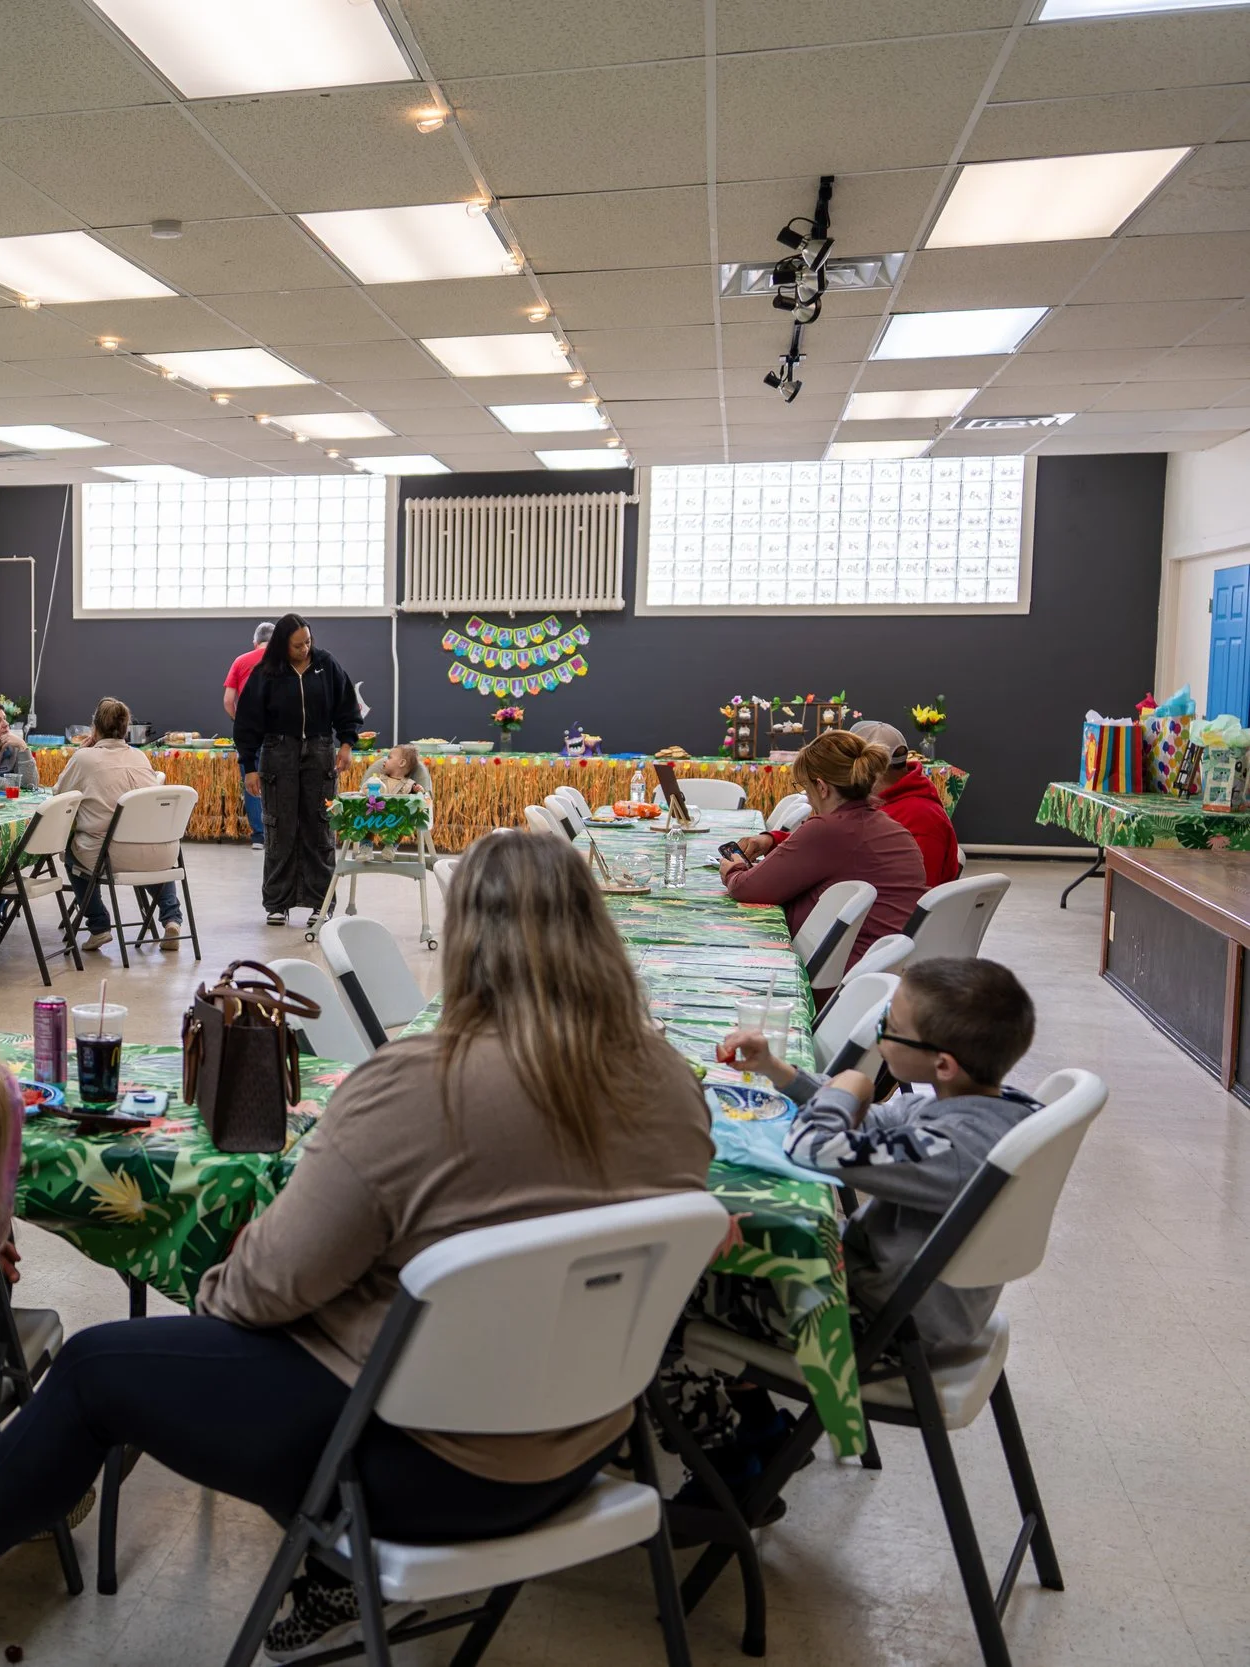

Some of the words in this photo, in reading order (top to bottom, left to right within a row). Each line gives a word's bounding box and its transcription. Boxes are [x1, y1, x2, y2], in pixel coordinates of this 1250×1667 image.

[482, 618, 558, 643] HAPPY
[469, 628, 586, 662] BIRTHDAY
[353, 814, 404, 830] one
